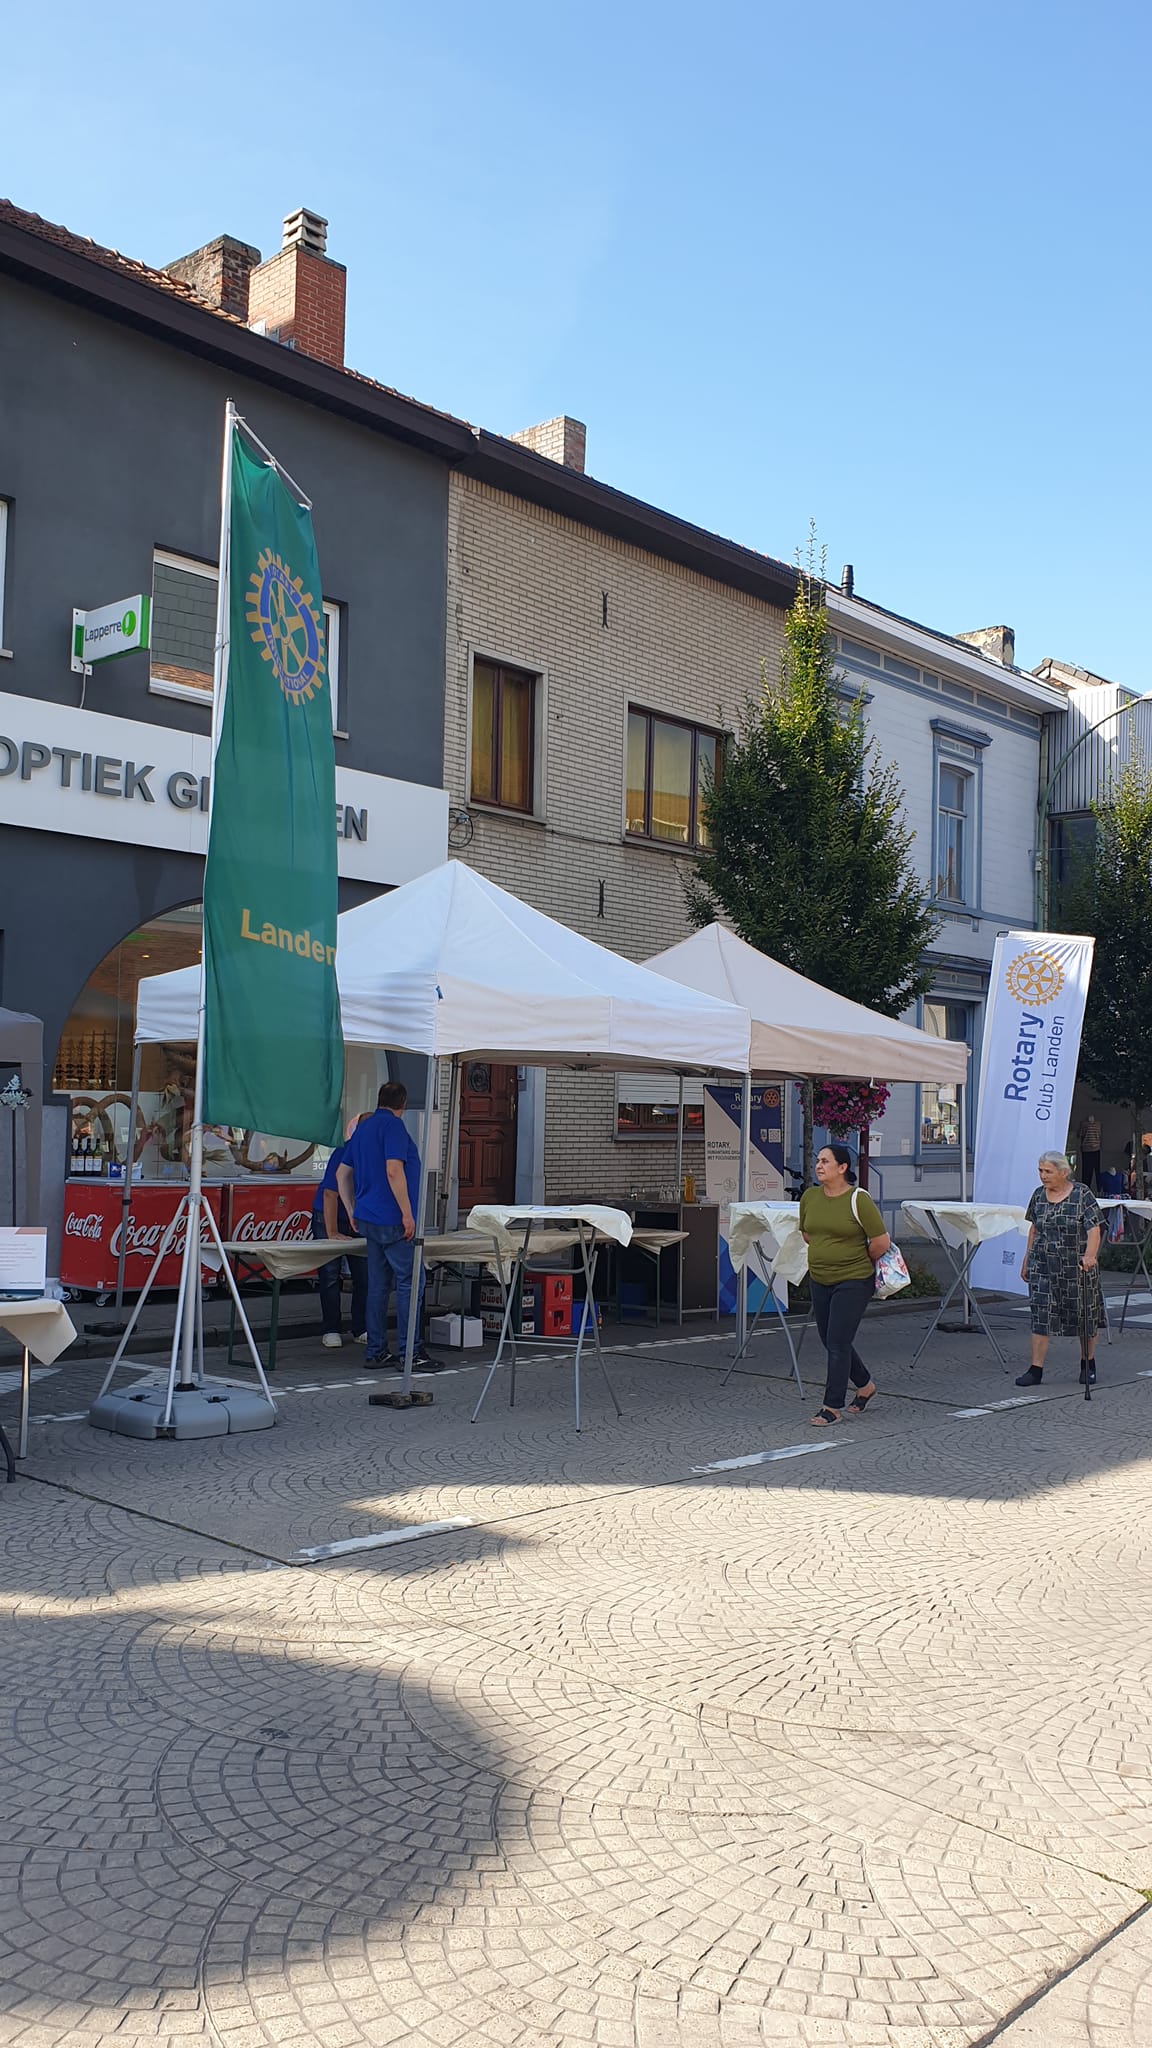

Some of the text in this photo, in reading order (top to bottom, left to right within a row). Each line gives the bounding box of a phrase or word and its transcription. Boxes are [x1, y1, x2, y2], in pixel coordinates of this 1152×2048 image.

[84, 621, 122, 642] Lapperre
[0, 735, 156, 803] OPTIEK
[240, 908, 337, 966] Landen
[1003, 1011, 1044, 1102] Rotary
[1035, 1015, 1065, 1121] Club Landen
[734, 1092, 762, 1104] Rary
[110, 1215, 211, 1258] Coca-Coa
[232, 1211, 314, 1241] Coca-Col
[481, 1291, 503, 1305] Duvel
